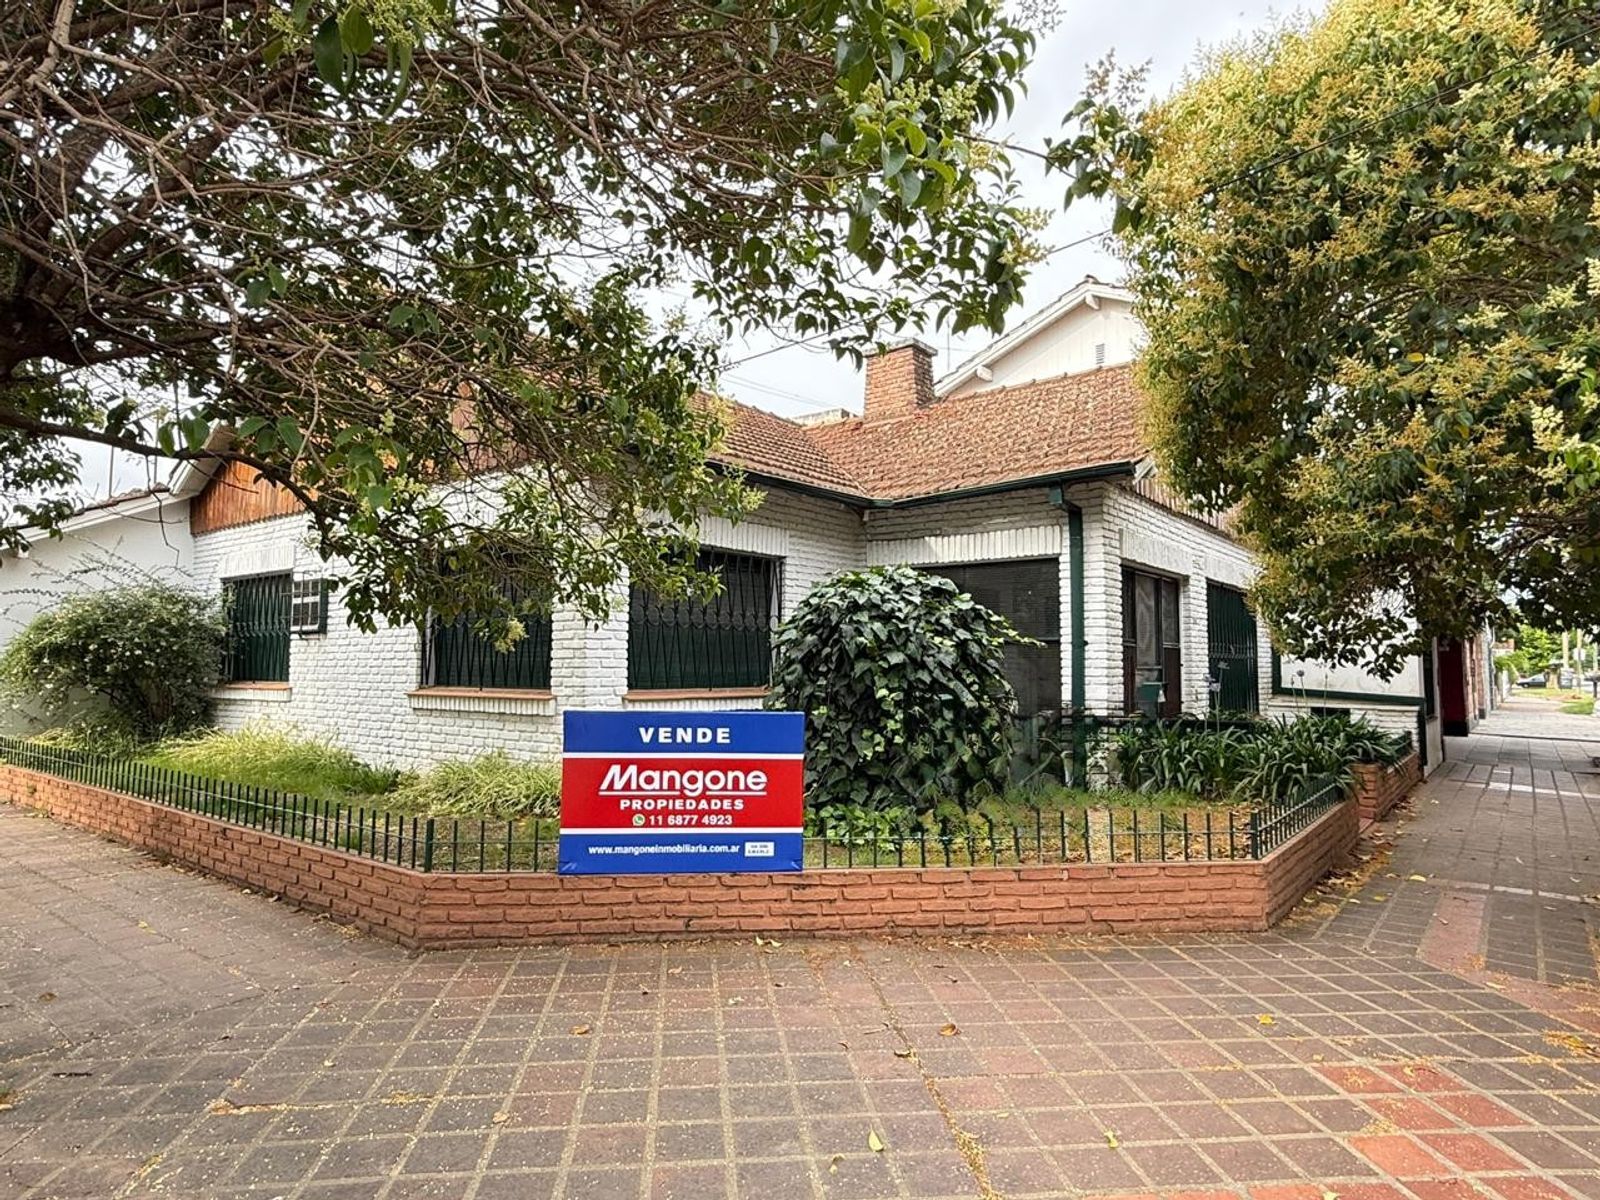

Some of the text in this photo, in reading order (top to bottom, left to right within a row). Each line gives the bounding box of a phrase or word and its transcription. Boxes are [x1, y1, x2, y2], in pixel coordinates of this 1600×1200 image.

[639, 727, 731, 743] VENDE
[600, 764, 768, 797] Mangone
[620, 799, 744, 810] PROPIEDADES
[649, 814, 733, 825] 11 6877 4923
[588, 843, 740, 856] www.mangoneinmobiliaria.com.ar
